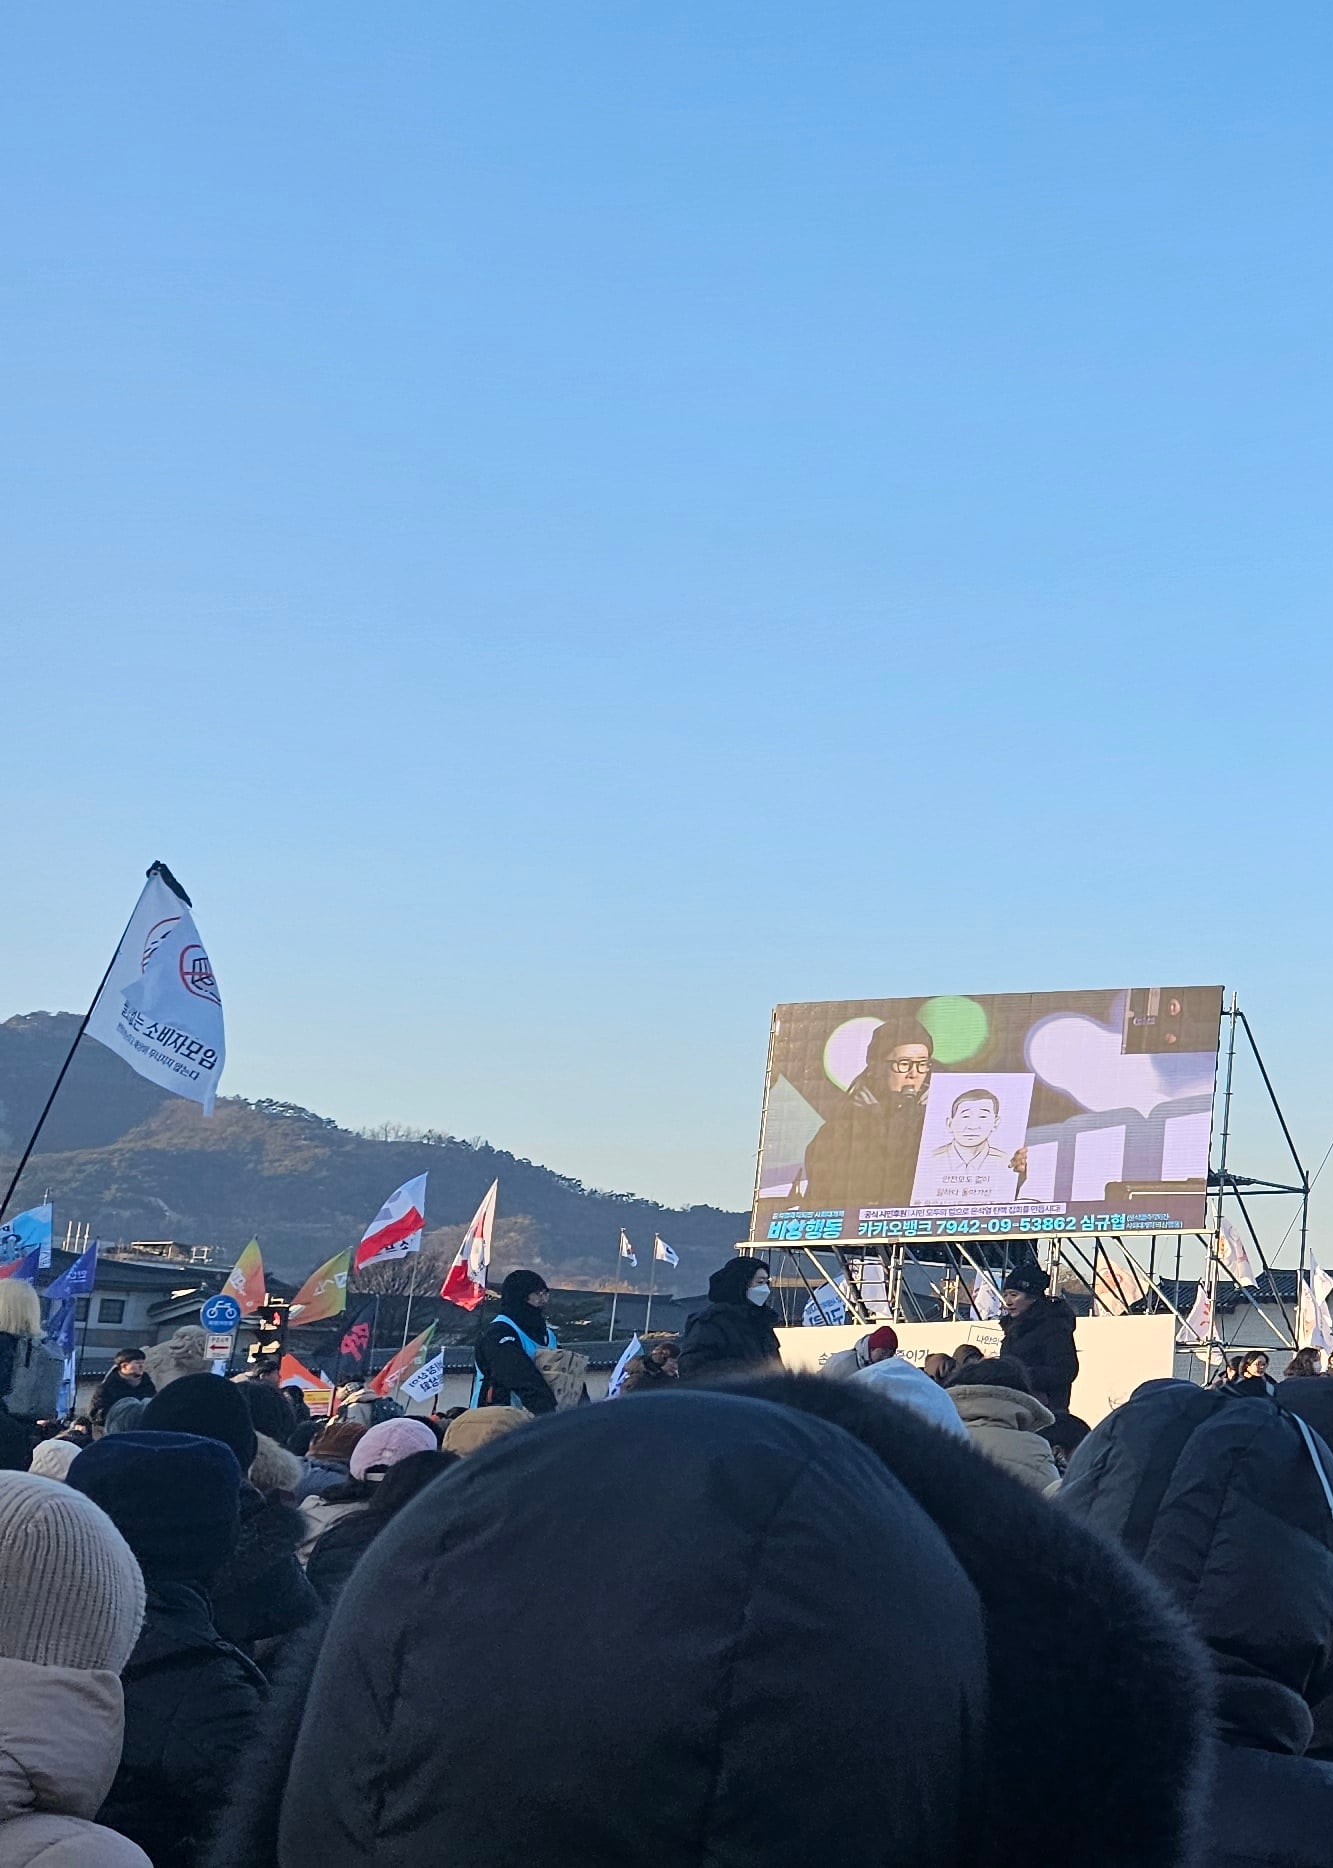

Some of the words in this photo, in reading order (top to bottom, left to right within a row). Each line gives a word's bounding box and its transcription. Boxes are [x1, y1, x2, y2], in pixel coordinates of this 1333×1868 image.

[142, 1022, 218, 1071] 소비자모임
[173, 1062, 200, 1081] 않는다
[767, 1218, 844, 1241] 비상행동
[858, 1219, 933, 1238] 카카오뱅크
[936, 1216, 1076, 1234] 7942-09-53862
[1080, 1213, 1126, 1231] 심규협
